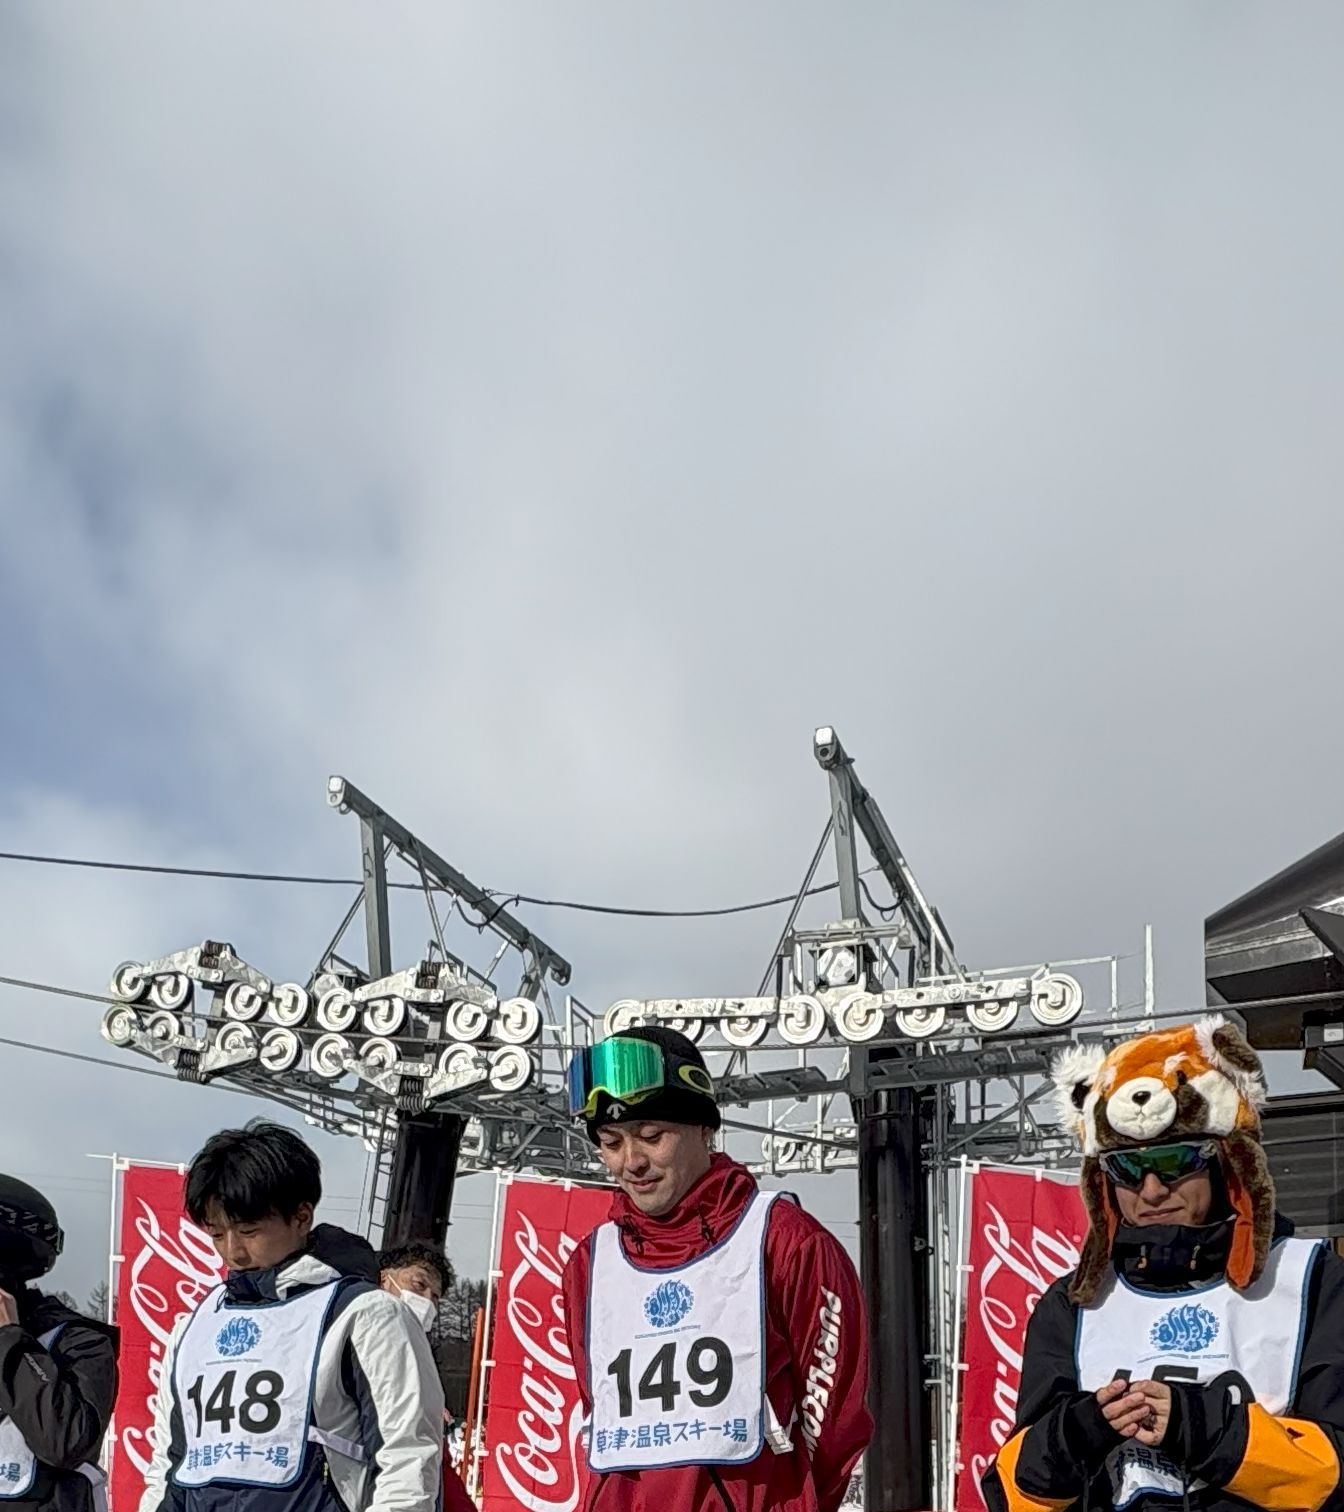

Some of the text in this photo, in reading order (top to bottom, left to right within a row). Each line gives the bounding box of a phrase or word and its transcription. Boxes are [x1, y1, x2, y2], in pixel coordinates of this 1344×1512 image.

[187, 1370, 285, 1438] 148
[608, 1337, 733, 1418] 149
[596, 1418, 748, 1453] 草津温泉スキー場
